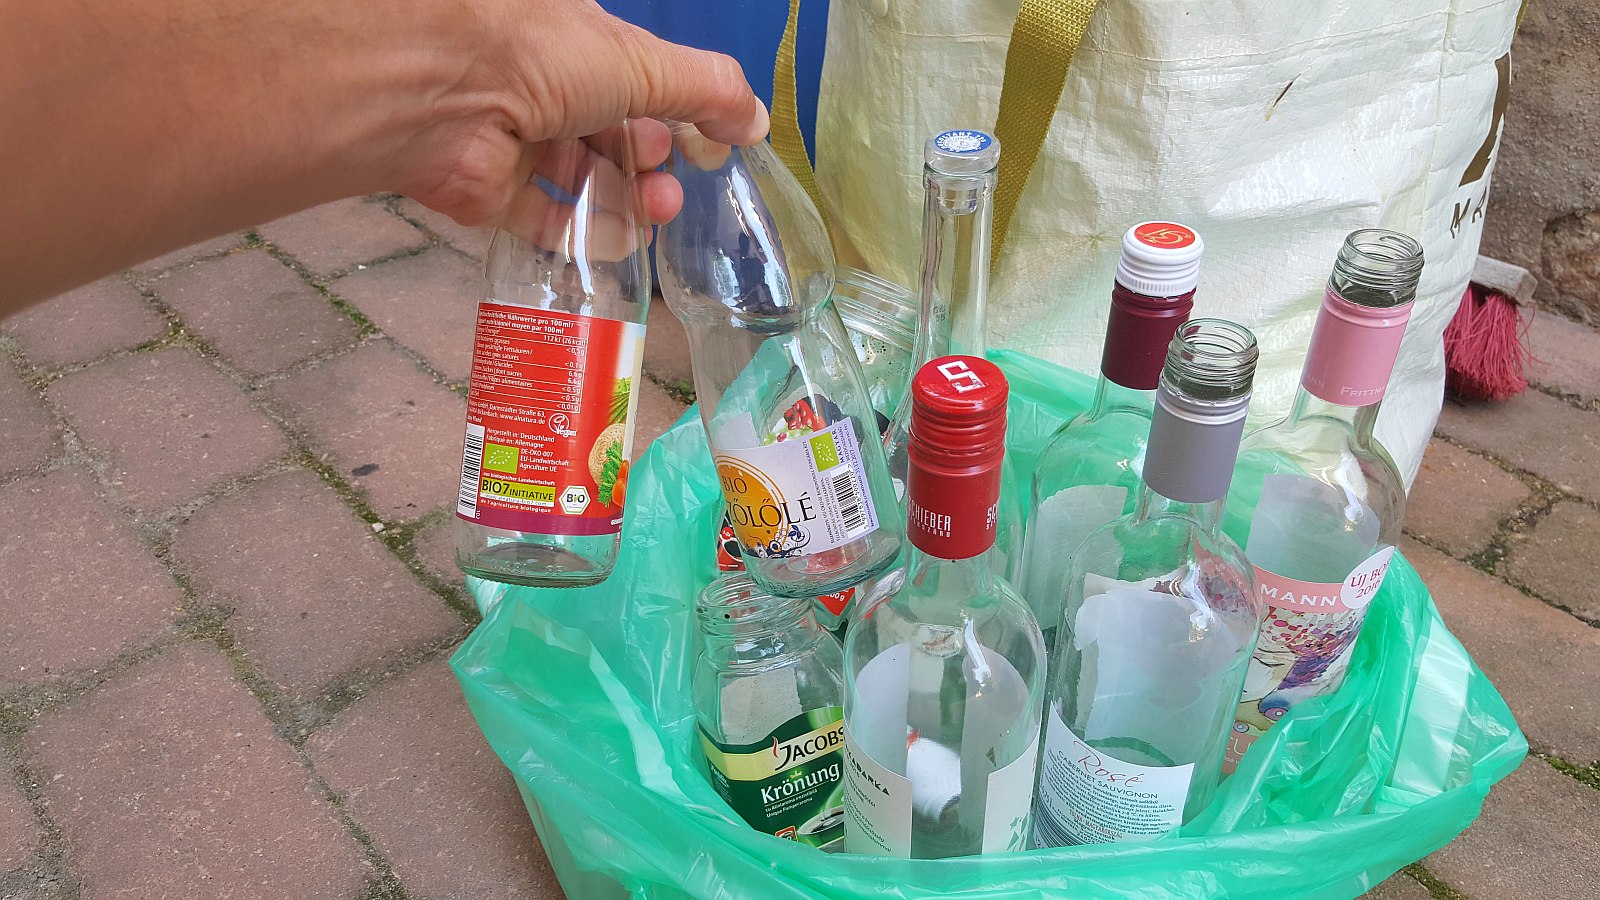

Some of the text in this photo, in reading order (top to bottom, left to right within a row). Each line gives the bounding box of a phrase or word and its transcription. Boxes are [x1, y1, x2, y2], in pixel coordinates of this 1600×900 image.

[518, 408, 537, 416] Straße
[515, 439, 544, 448] Allemagne
[520, 432, 554, 442] Deutschland
[831, 429, 845, 463] MAGYAR
[722, 476, 747, 494] BIO
[1351, 572, 1367, 588] ÚJ
[1261, 583, 1338, 606] MANN
[1058, 750, 1096, 782] CABERNET
[1098, 781, 1158, 798] SAUVIGNON
[1074, 741, 1144, 788] Rosé
[761, 762, 840, 804] Krönung
